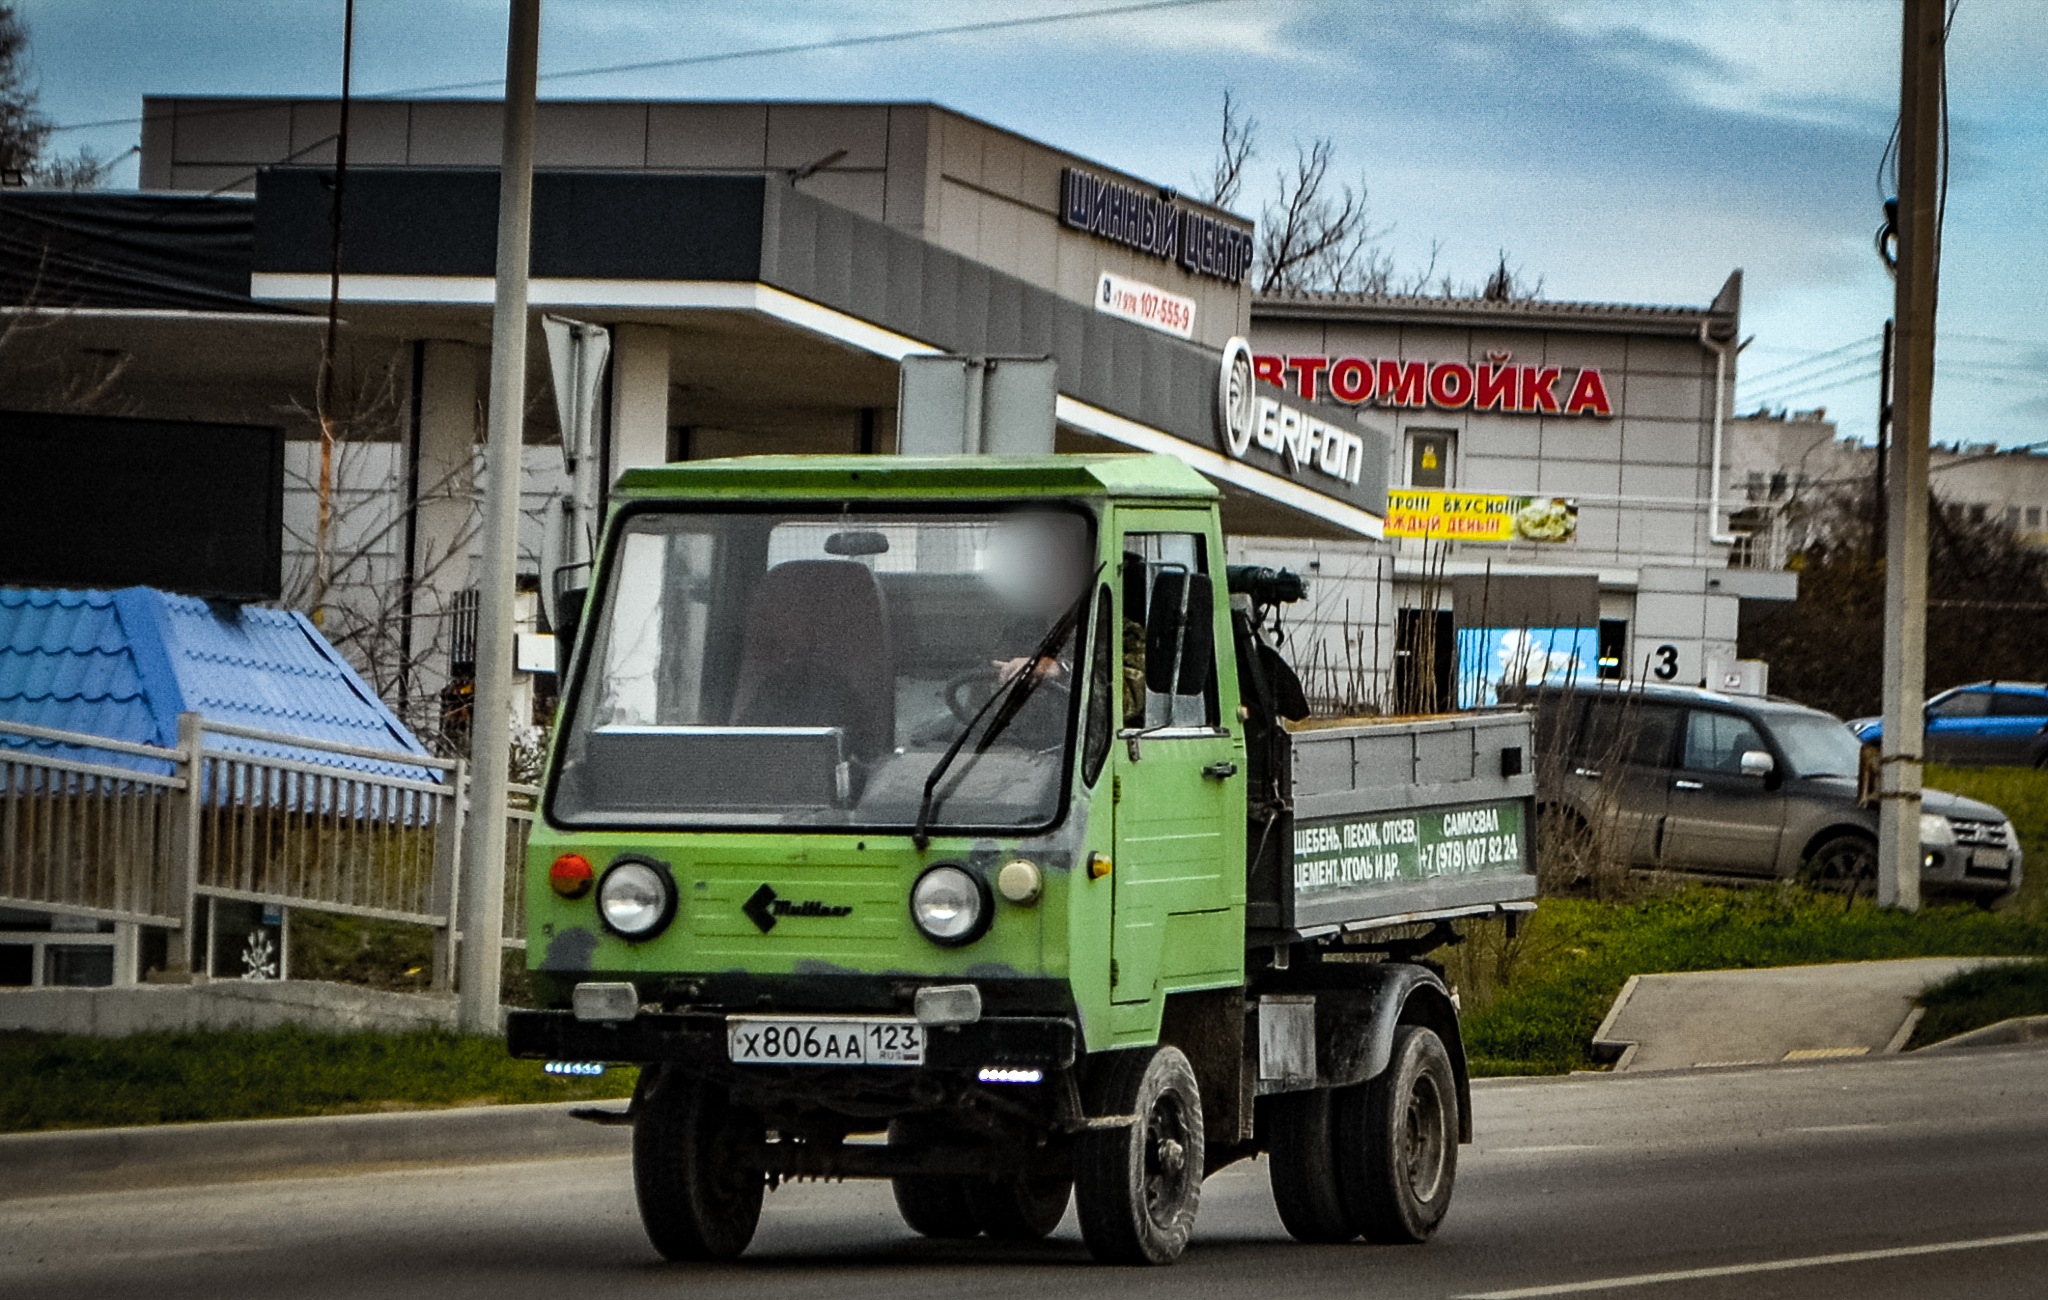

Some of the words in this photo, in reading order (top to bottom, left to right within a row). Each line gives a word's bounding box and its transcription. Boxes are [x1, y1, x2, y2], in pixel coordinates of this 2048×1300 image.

[1067, 167, 1180, 263] ШИННЫЙ
[1185, 208, 1254, 284] ЦЕНТР
[1141, 291, 1190, 331] 107-555-9
[1253, 349, 1613, 417] ВТОМОЙКА
[1388, 496, 1430, 512] ТРО!!!
[1384, 514, 1441, 532] АЖДЫЙ
[1653, 644, 1679, 680] 3
[1294, 826, 1343, 858] ЩЕБЕНЬ,
[1344, 821, 1382, 851] ПЕСОК,
[1382, 818, 1418, 846] ОТСЕВ,
[1443, 808, 1499, 838] САМОСВАЛ
[1340, 856, 1374, 882] УГОЛЬ
[1375, 854, 1383, 879] И
[1384, 852, 1401, 881] ДР.
[1421, 843, 1434, 870] +7
[1436, 840, 1465, 874] (978)
[1466, 837, 1486, 865] 007
[1488, 835, 1502, 863] 82
[1504, 833, 1518, 860] 24
[743, 1026, 862, 1059] Х806АА
[870, 1025, 919, 1050] 123
